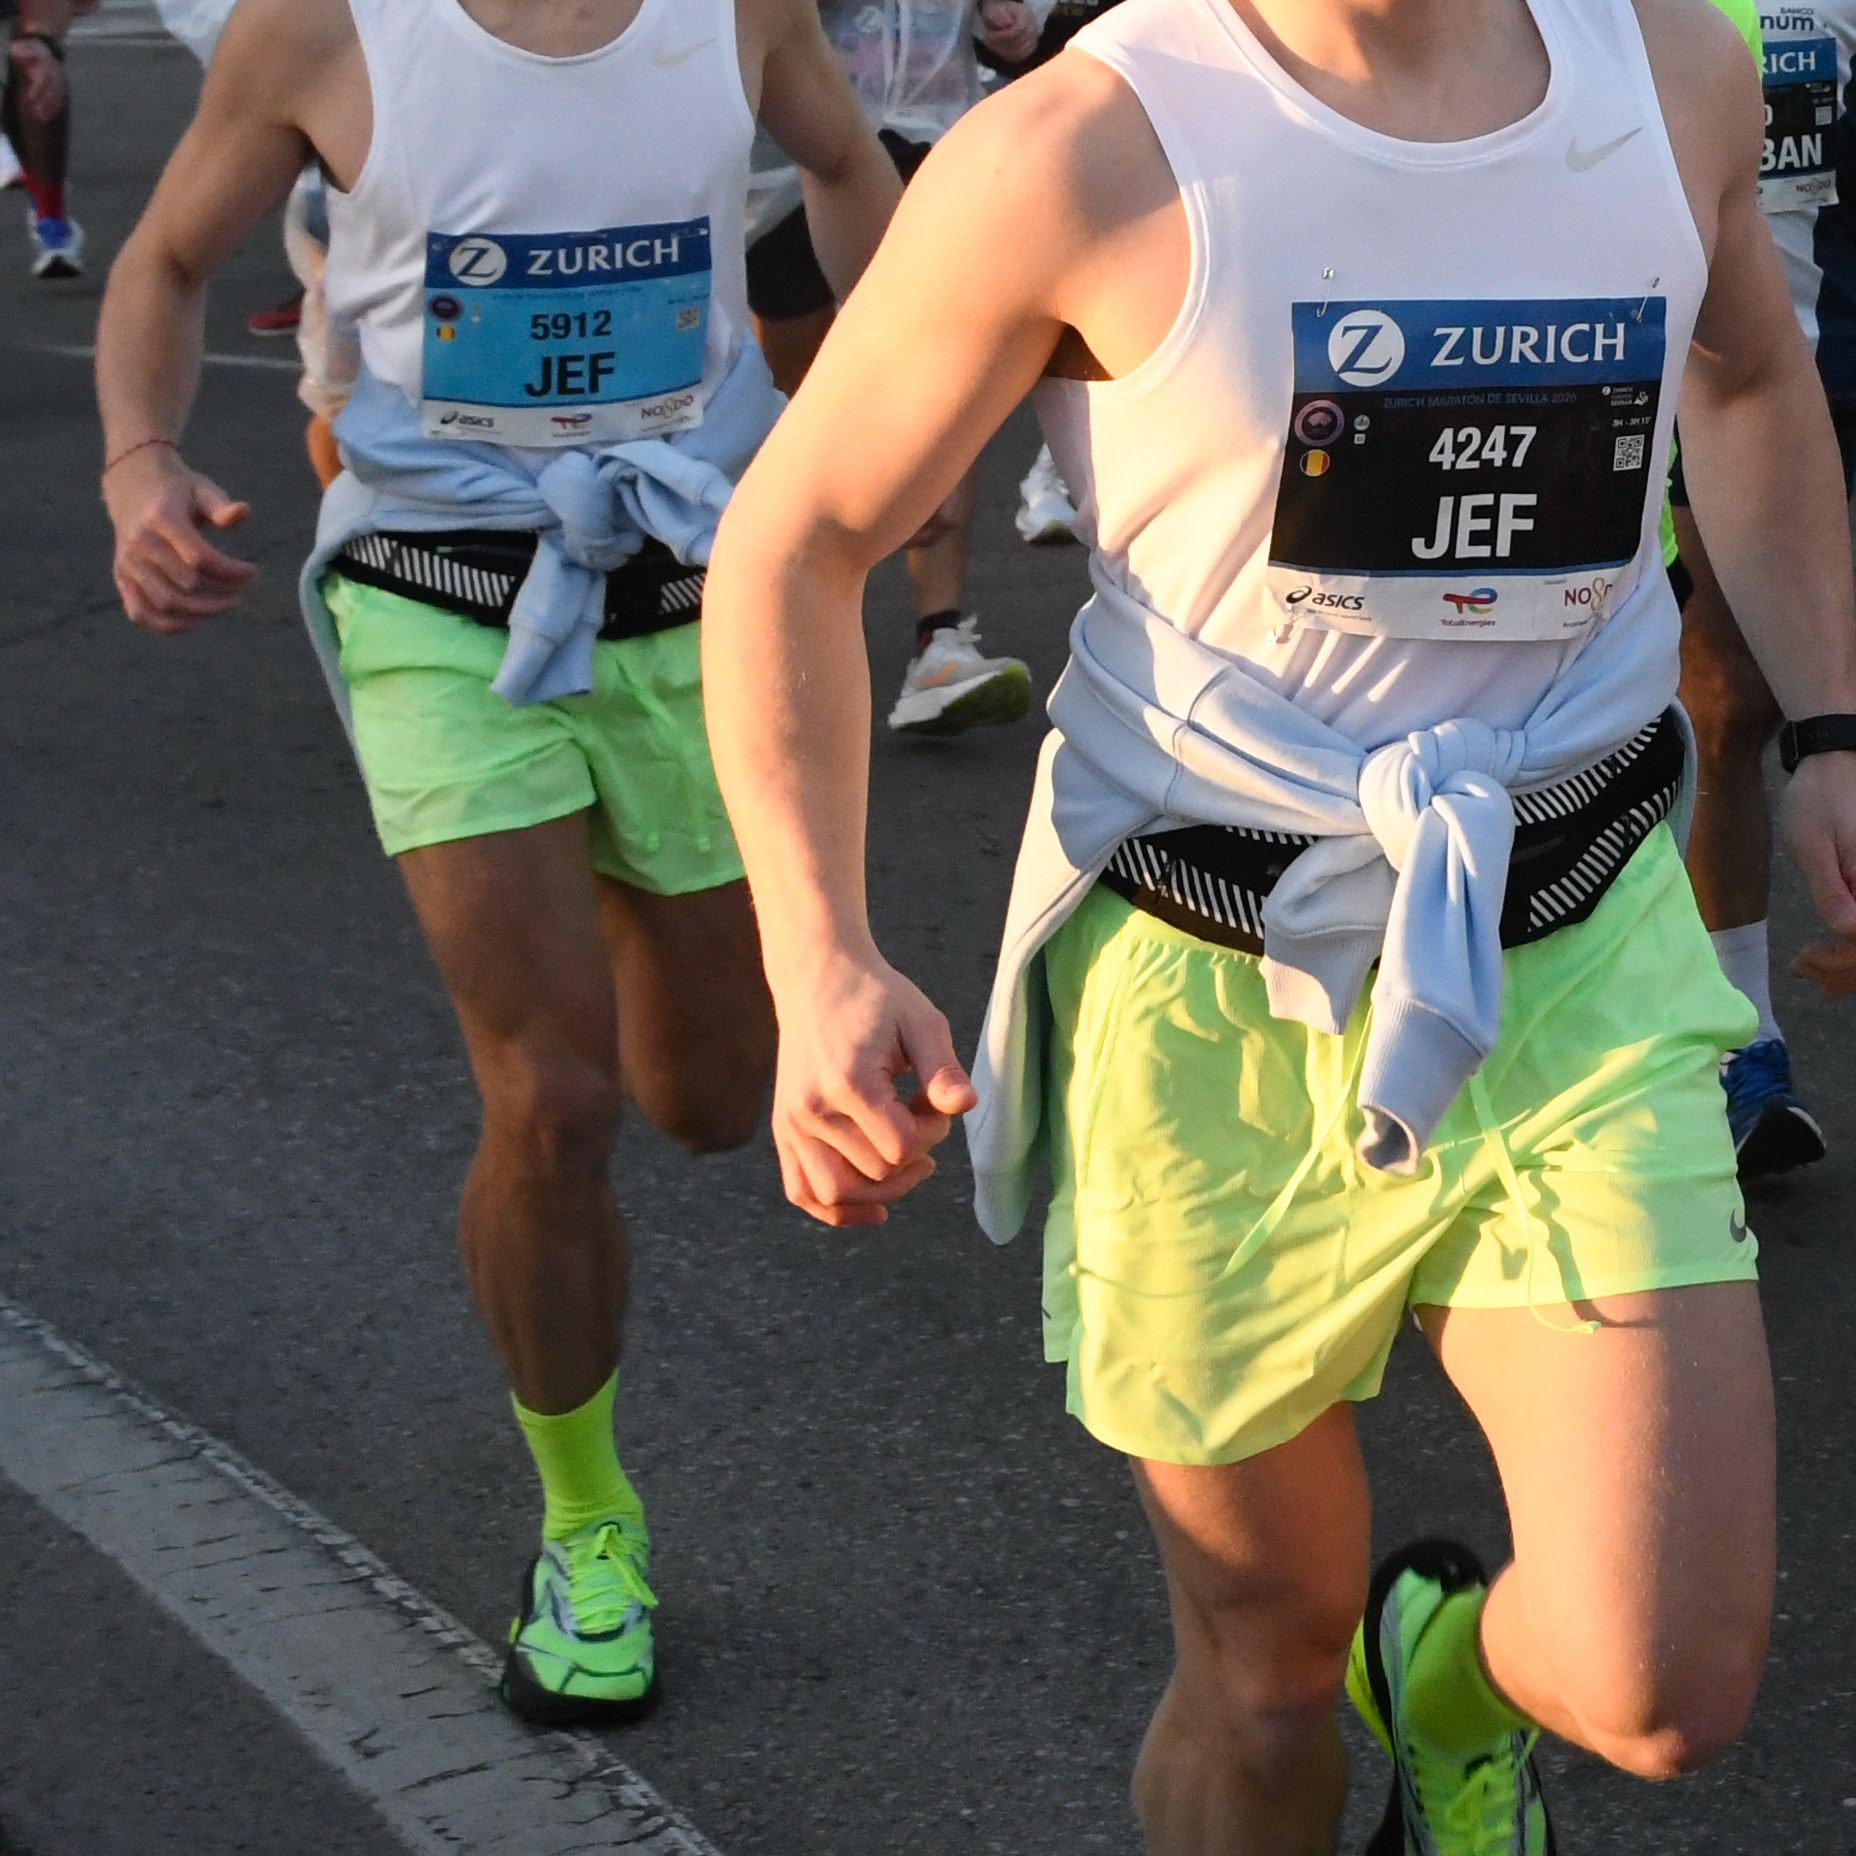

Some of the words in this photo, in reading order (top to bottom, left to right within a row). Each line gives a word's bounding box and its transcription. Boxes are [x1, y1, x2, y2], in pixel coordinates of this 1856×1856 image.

[527, 237, 680, 276] ZURICH
[530, 310, 612, 341] 5912
[1430, 322, 1626, 367] ZURICH
[524, 351, 615, 397] JEF
[1383, 396, 1425, 408] ZURICH
[1428, 393, 1485, 407] MARATÓN
[1487, 393, 1501, 404] DE
[1505, 393, 1548, 404] SEVILLA
[1428, 425, 1537, 471] 4247
[1411, 493, 1538, 560] JEF
[1312, 590, 1366, 611] asics
